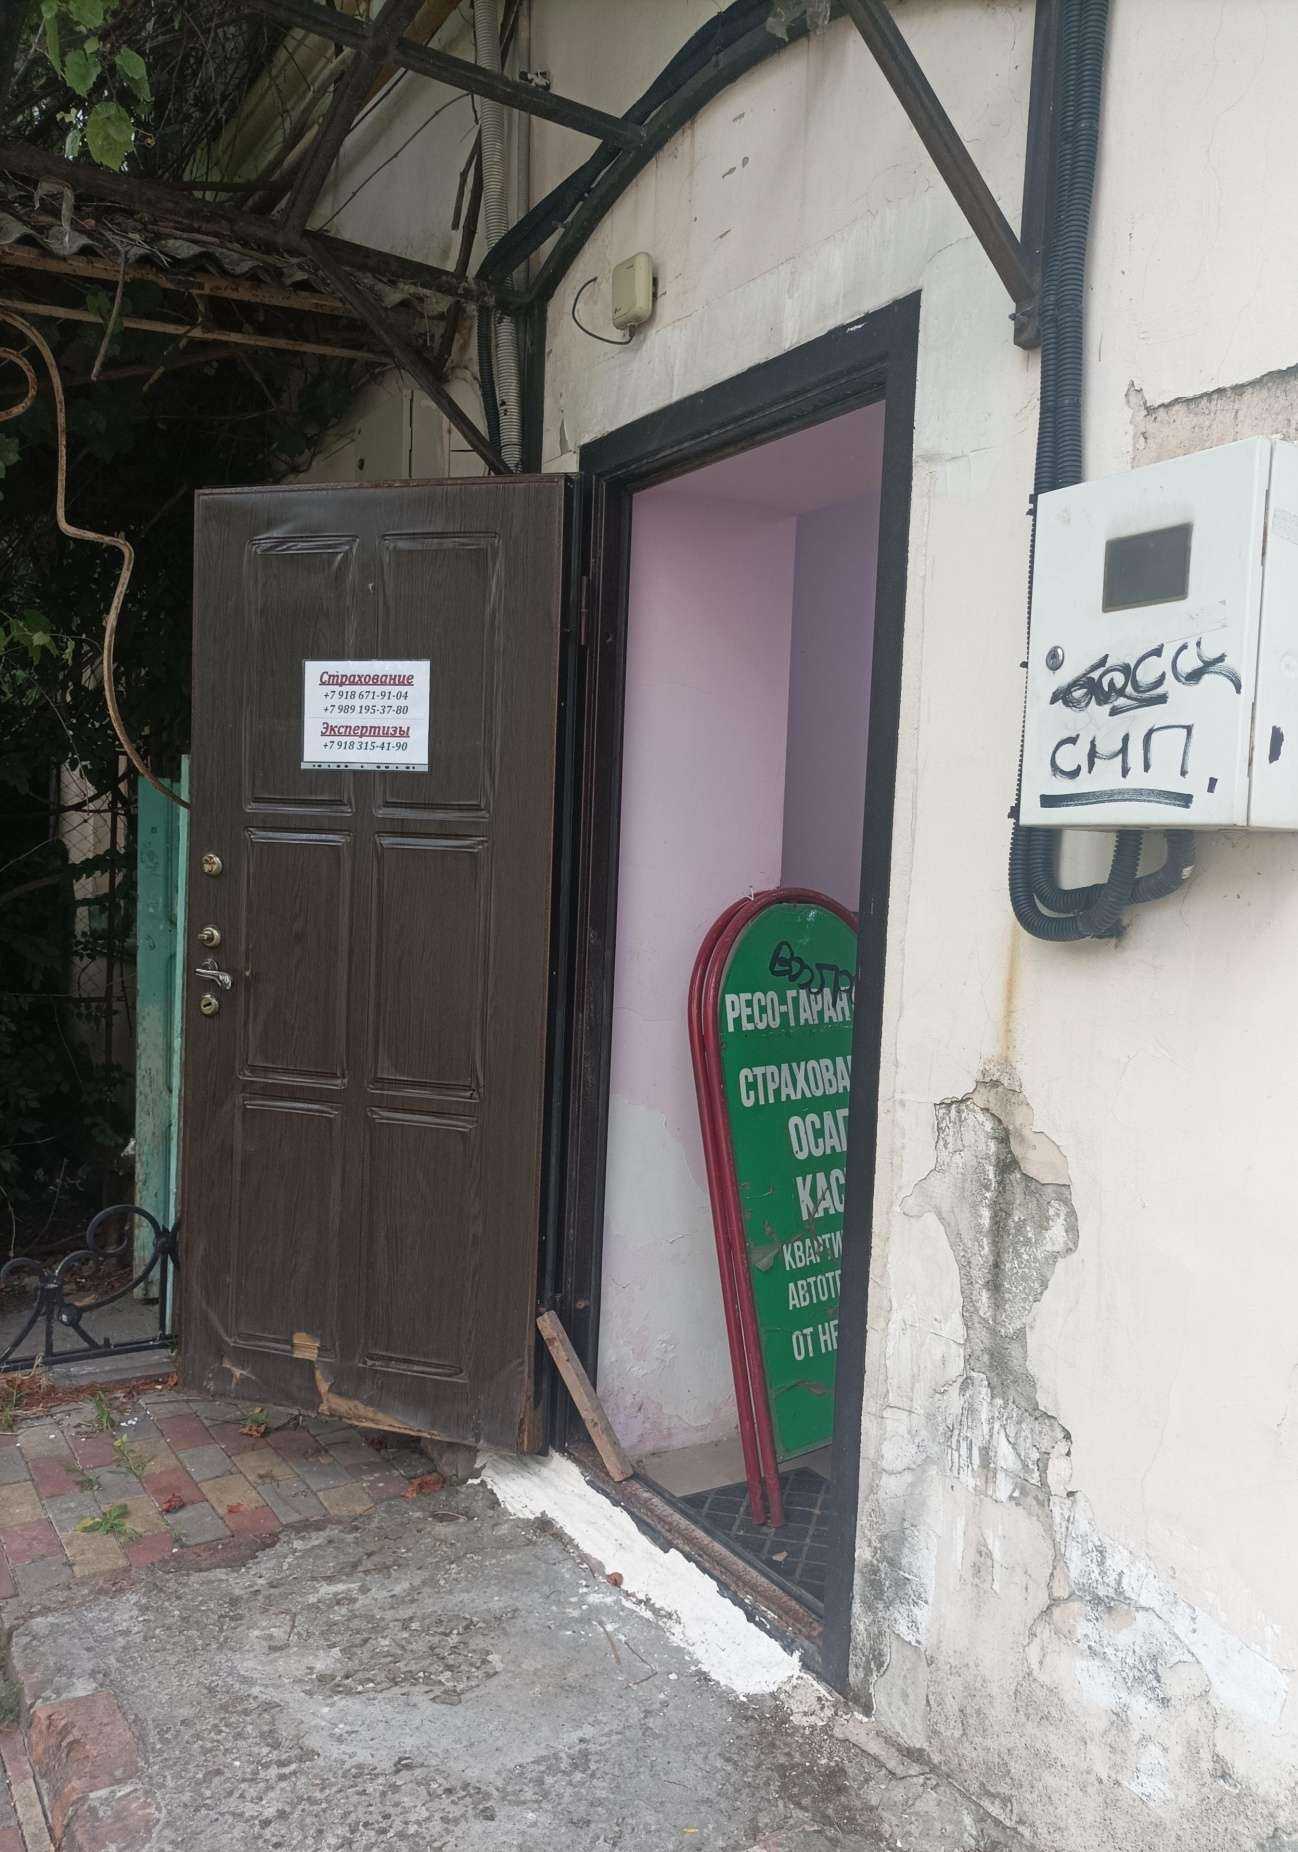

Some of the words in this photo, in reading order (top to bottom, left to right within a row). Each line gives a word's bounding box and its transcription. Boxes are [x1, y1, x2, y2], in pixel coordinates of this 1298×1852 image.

[319, 671, 415, 687] Страхование
[324, 691, 336, 700] +7
[339, 691, 356, 700] 918
[358, 691, 408, 701] 671-91-04
[324, 705, 336, 714] +7
[338, 705, 356, 714] 989
[359, 705, 409, 715] 195-37-80
[320, 722, 411, 738] Экспертизы
[323, 741, 335, 750] +7
[337, 741, 355, 750] 918
[357, 741, 408, 752] 315-41-90
[725, 985, 855, 1032] РЕСО-ГАРАН
[739, 1056, 851, 1107] СТРАХОВА
[796, 1168, 847, 1221] КАС
[792, 1327, 815, 1361] ОТ
